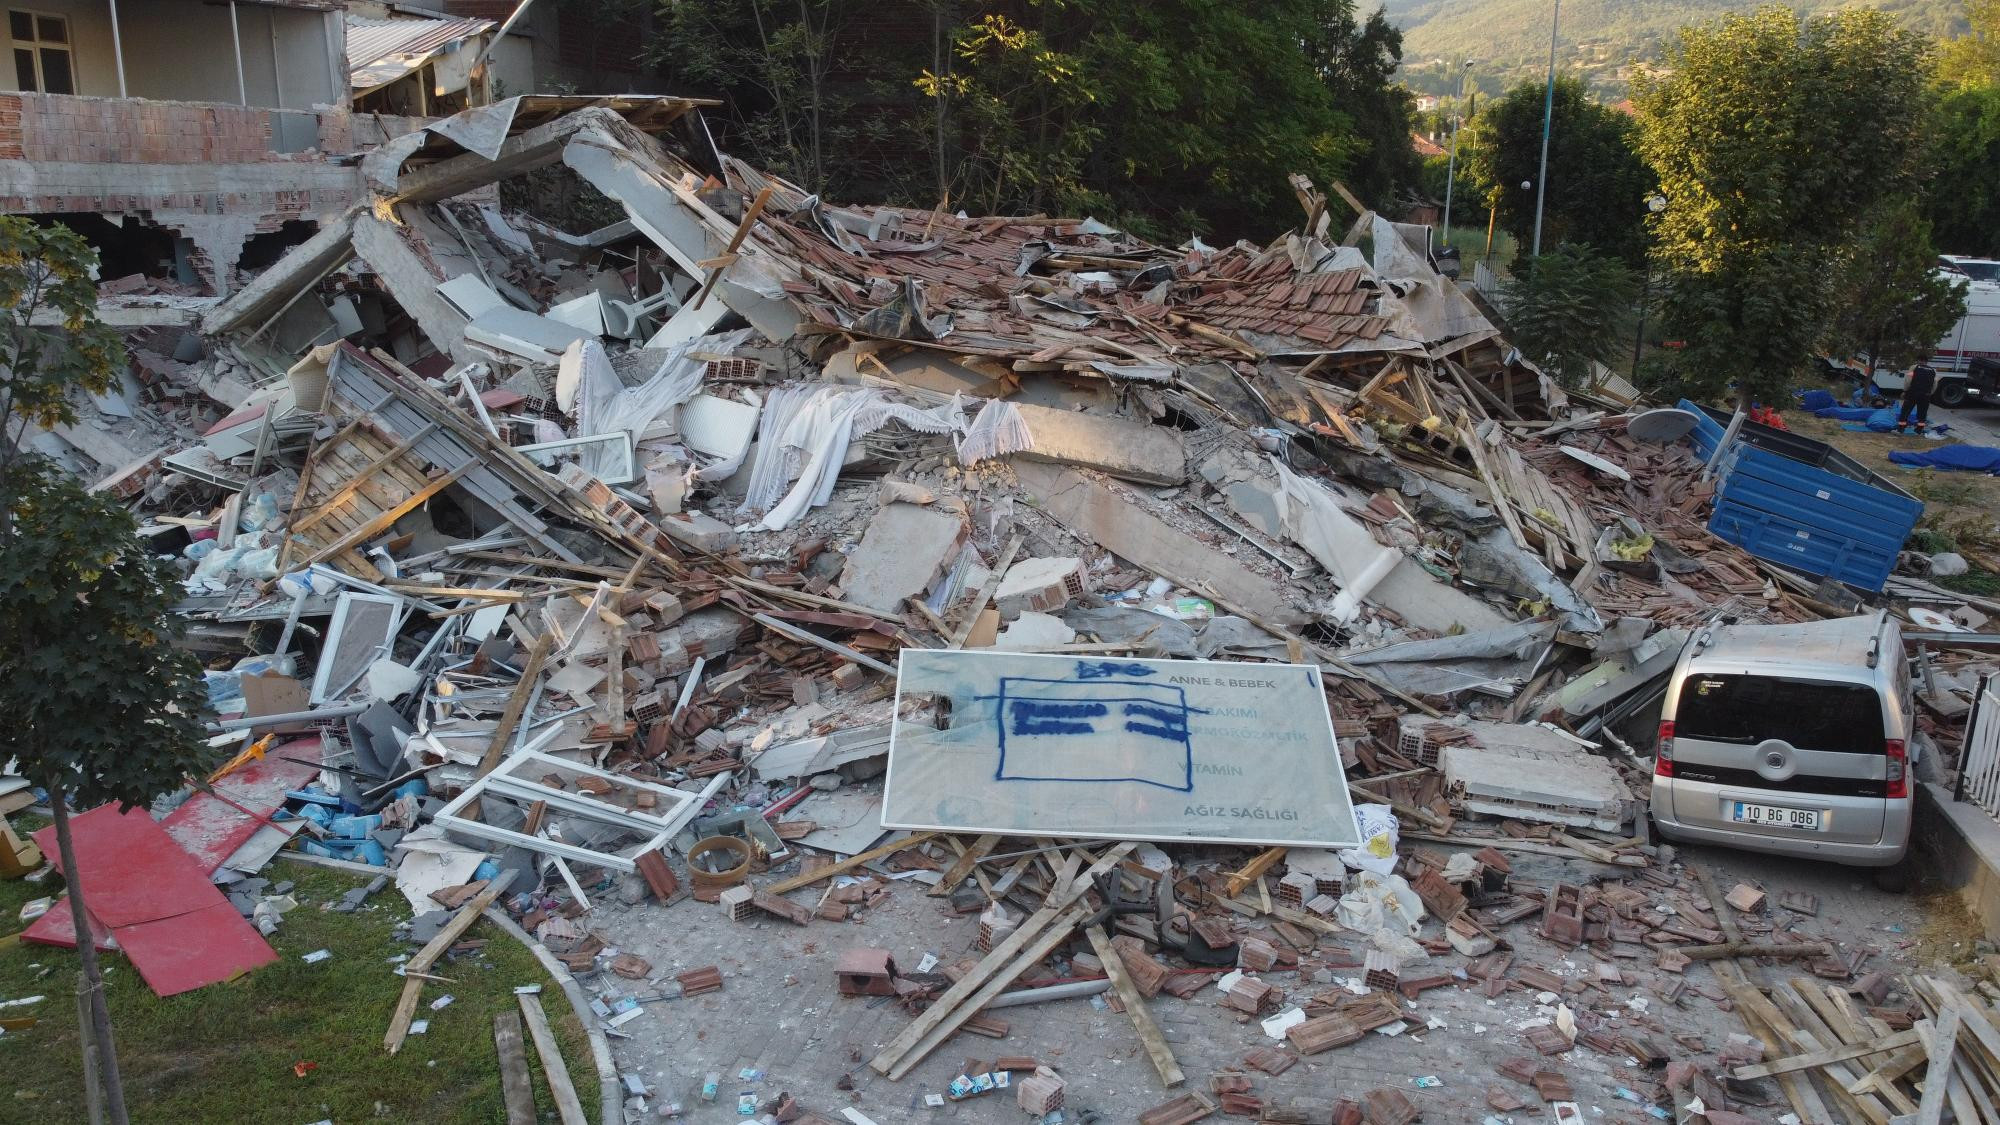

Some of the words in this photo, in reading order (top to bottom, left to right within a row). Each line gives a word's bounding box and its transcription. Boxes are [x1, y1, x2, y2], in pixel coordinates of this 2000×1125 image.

[1169, 675, 1210, 686] ANNE
[1215, 679, 1225, 687] &
[1229, 679, 1276, 689] BEBEK
[1178, 761, 1243, 776] VTAMİN
[1184, 804, 1226, 817] AĞIZ
[1231, 806, 1299, 821] SAĞLIĞI
[1747, 806, 1760, 819] 10
[1768, 808, 1783, 821] BG
[1790, 811, 1813, 824] 086
